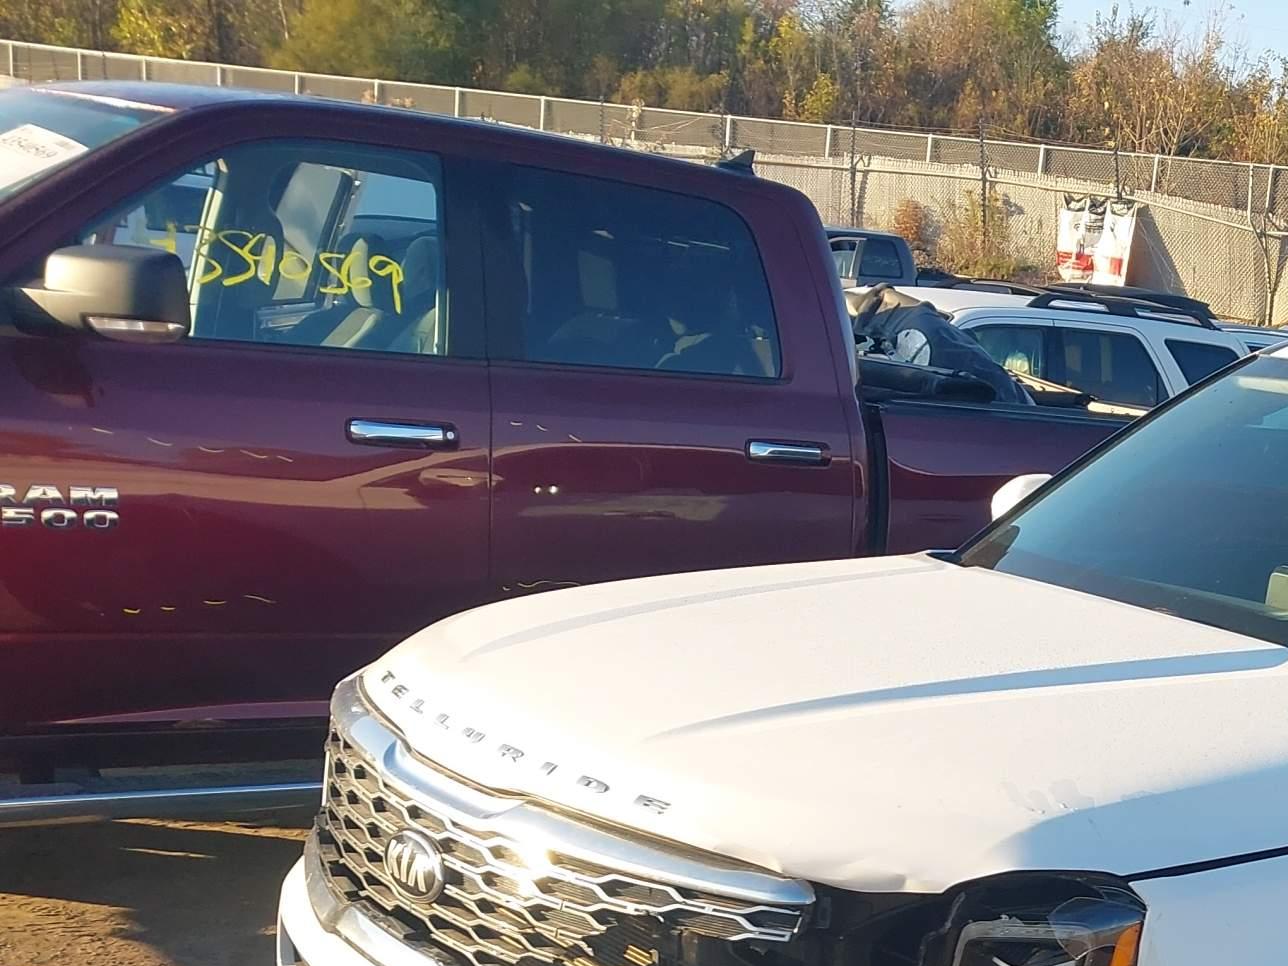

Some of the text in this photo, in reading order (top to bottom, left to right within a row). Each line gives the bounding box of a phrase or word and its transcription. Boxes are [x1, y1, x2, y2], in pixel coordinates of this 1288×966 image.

[0, 484, 119, 506] RAM
[381, 670, 672, 814] TELLURIDE
[385, 839, 437, 893] KIA
